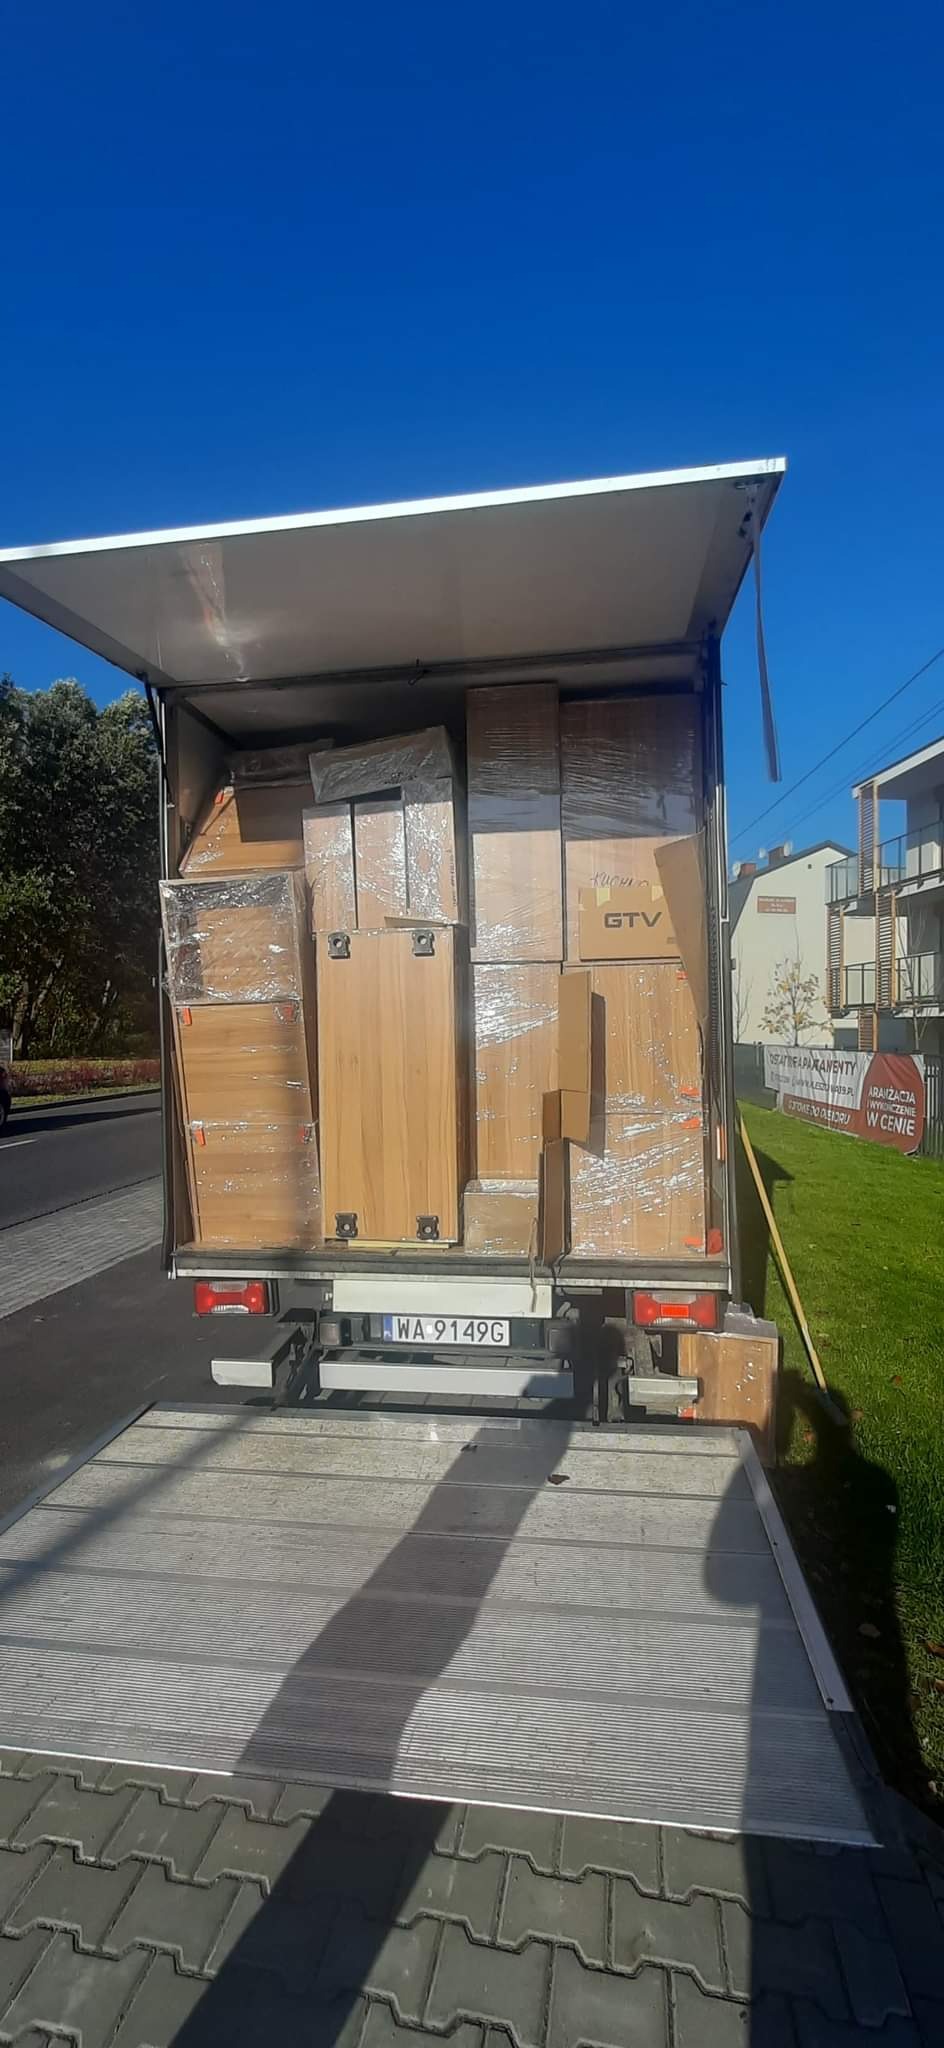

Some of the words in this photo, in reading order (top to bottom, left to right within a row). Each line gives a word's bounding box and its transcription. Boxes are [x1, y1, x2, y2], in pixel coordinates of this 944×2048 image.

[604, 911, 663, 929] GTV
[868, 1085, 916, 1105] ARANŻACJA
[866, 1111, 879, 1128] W
[880, 1114, 916, 1137] CENIE
[397, 1318, 425, 1340] WA
[434, 1319, 504, 1343] 9149G
